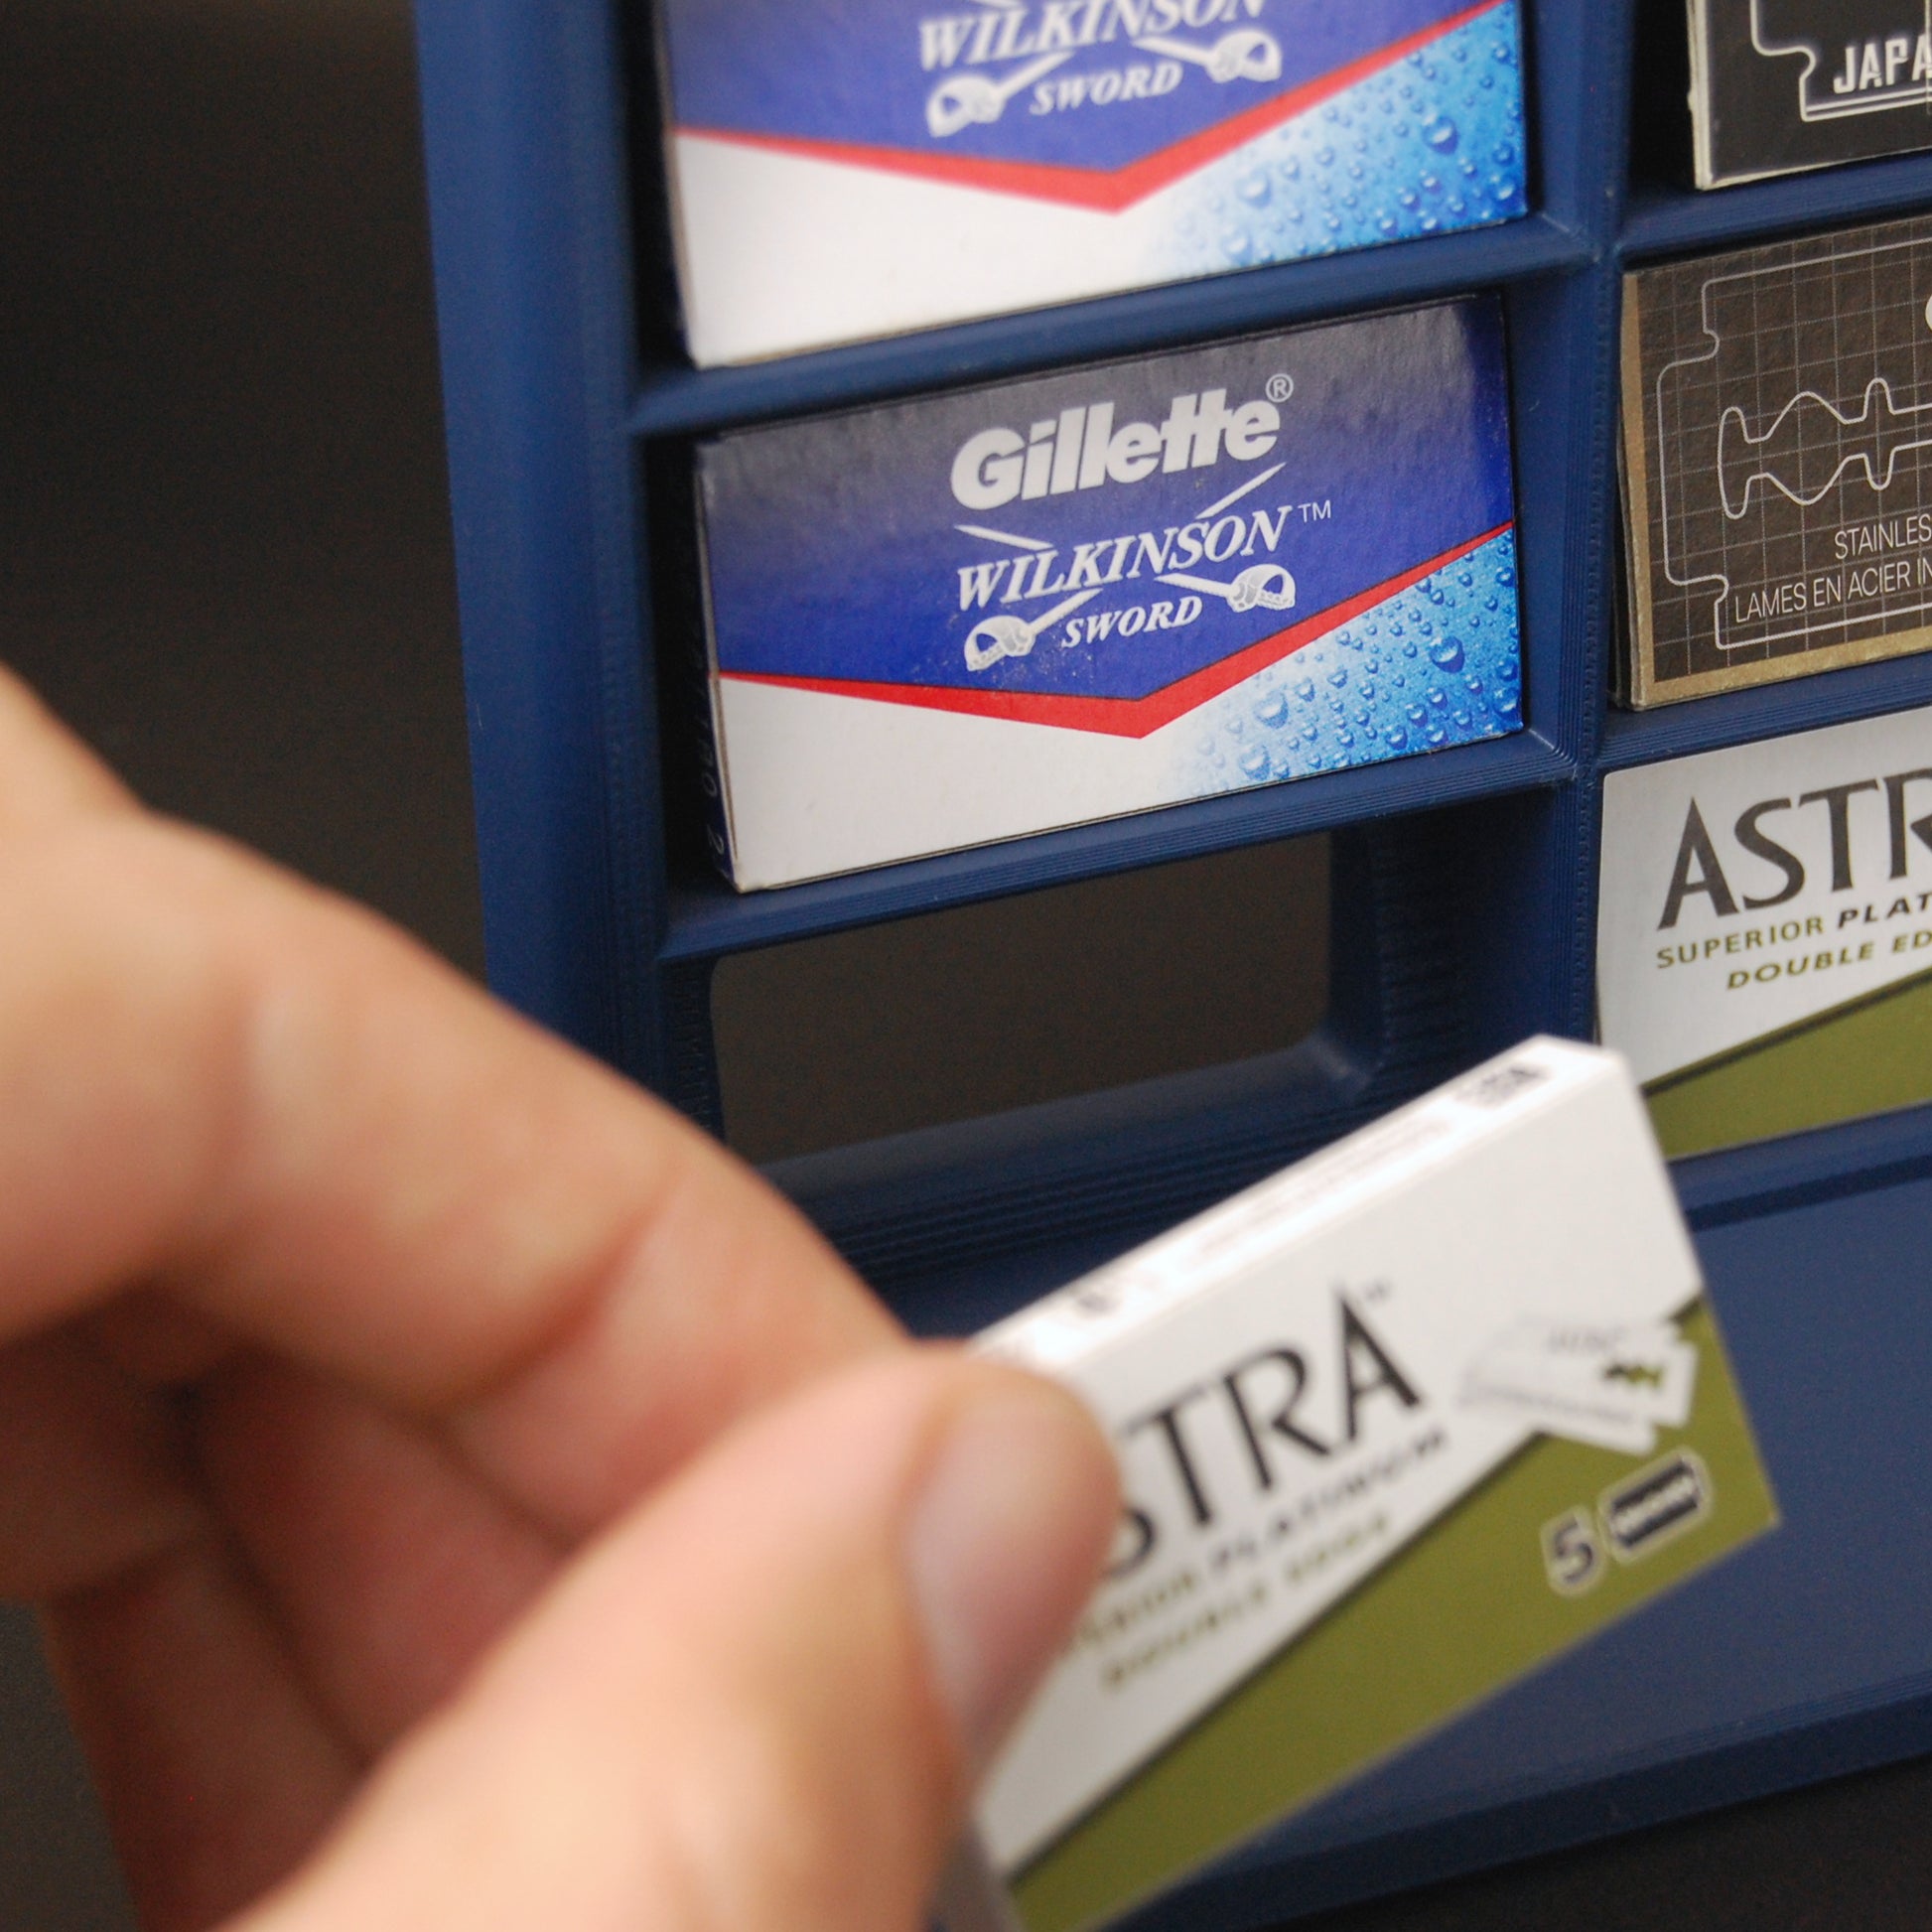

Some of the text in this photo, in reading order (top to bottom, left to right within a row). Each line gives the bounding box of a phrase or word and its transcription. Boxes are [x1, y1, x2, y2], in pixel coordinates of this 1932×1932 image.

[1029, 61, 1183, 116] SWORD
[1835, 513, 1932, 560] STAINLES
[1734, 587, 1807, 623] LAMES
[1813, 575, 1841, 608] EN
[1847, 560, 1911, 601] ACIER
[1060, 597, 1203, 648] SWORD
[1656, 915, 1825, 971] SUPERIOR
[1726, 941, 1874, 991] DOUBLE
[1546, 1510, 1600, 1590] 5
